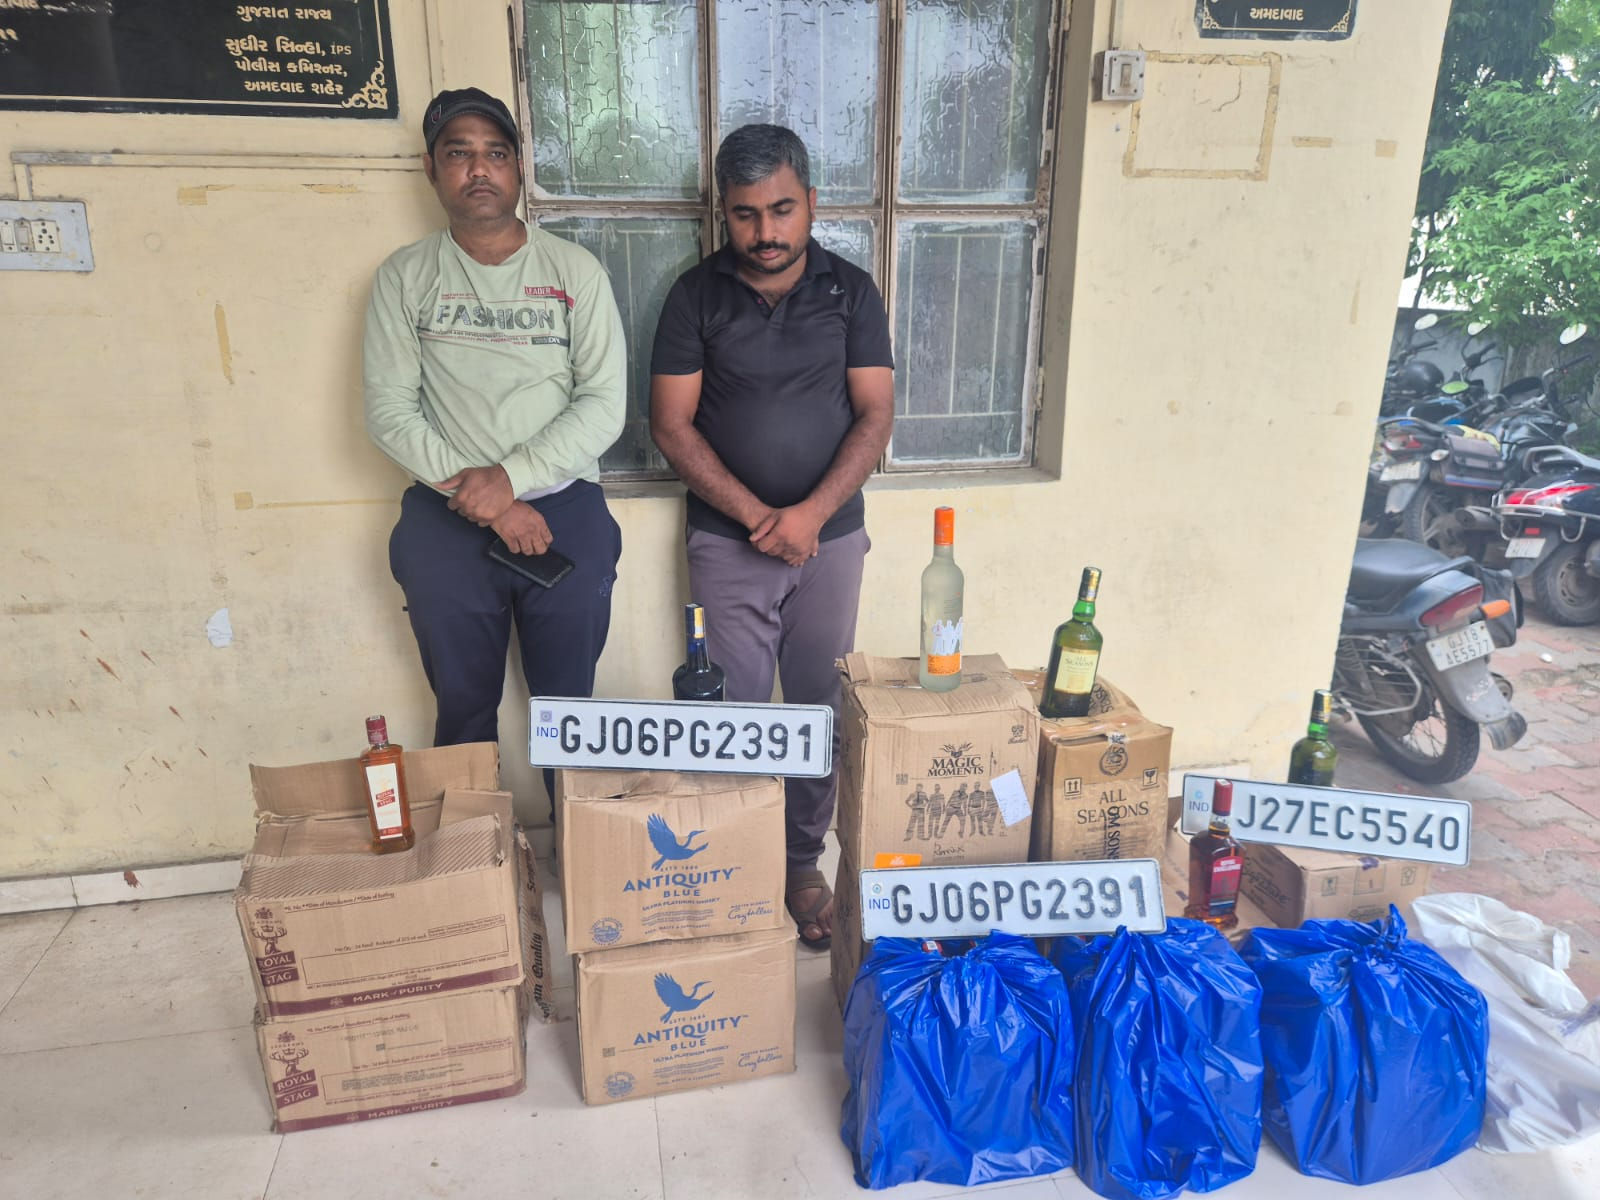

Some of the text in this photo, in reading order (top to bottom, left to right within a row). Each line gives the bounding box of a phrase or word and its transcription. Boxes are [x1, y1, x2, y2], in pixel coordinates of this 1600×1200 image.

[236, 5, 332, 22] ગુજરાત રાજ્ય
[1250, 7, 1304, 21] અમદાવાદ
[331, 43, 352, 55] IPS
[235, 57, 281, 73] પોલીસ
[311, 79, 344, 95] શહેર
[526, 287, 551, 296] LEADER
[436, 304, 555, 330] FASHION
[536, 726, 559, 739] IND
[560, 715, 812, 762] GJ06PG2391
[931, 757, 982, 769] MAGIC
[928, 766, 984, 777] MOMENTS
[1099, 789, 1127, 805] ALL
[1077, 801, 1149, 824] SEAONS
[1189, 801, 1210, 812] IND
[1237, 795, 1461, 852] J27EC5540
[623, 867, 734, 892] ANTIQUITY
[663, 889, 701, 898] BLUE
[891, 875, 1147, 924] GJ06PG2391
[868, 898, 891, 910] IND
[532, 932, 544, 980] Quality
[353, 990, 389, 1003] MARK
[399, 982, 444, 998] PURITY
[633, 1015, 742, 1046] ANTIQUITY
[670, 1038, 707, 1051] BLUE
[653, 1055, 673, 1063] ULTRA
[674, 1049, 705, 1059] PLATINUM
[276, 1073, 312, 1091] ROYAL
[283, 1089, 311, 1105] STAG
[368, 1107, 401, 1119] MARK
[411, 1100, 454, 1112] PURITY
